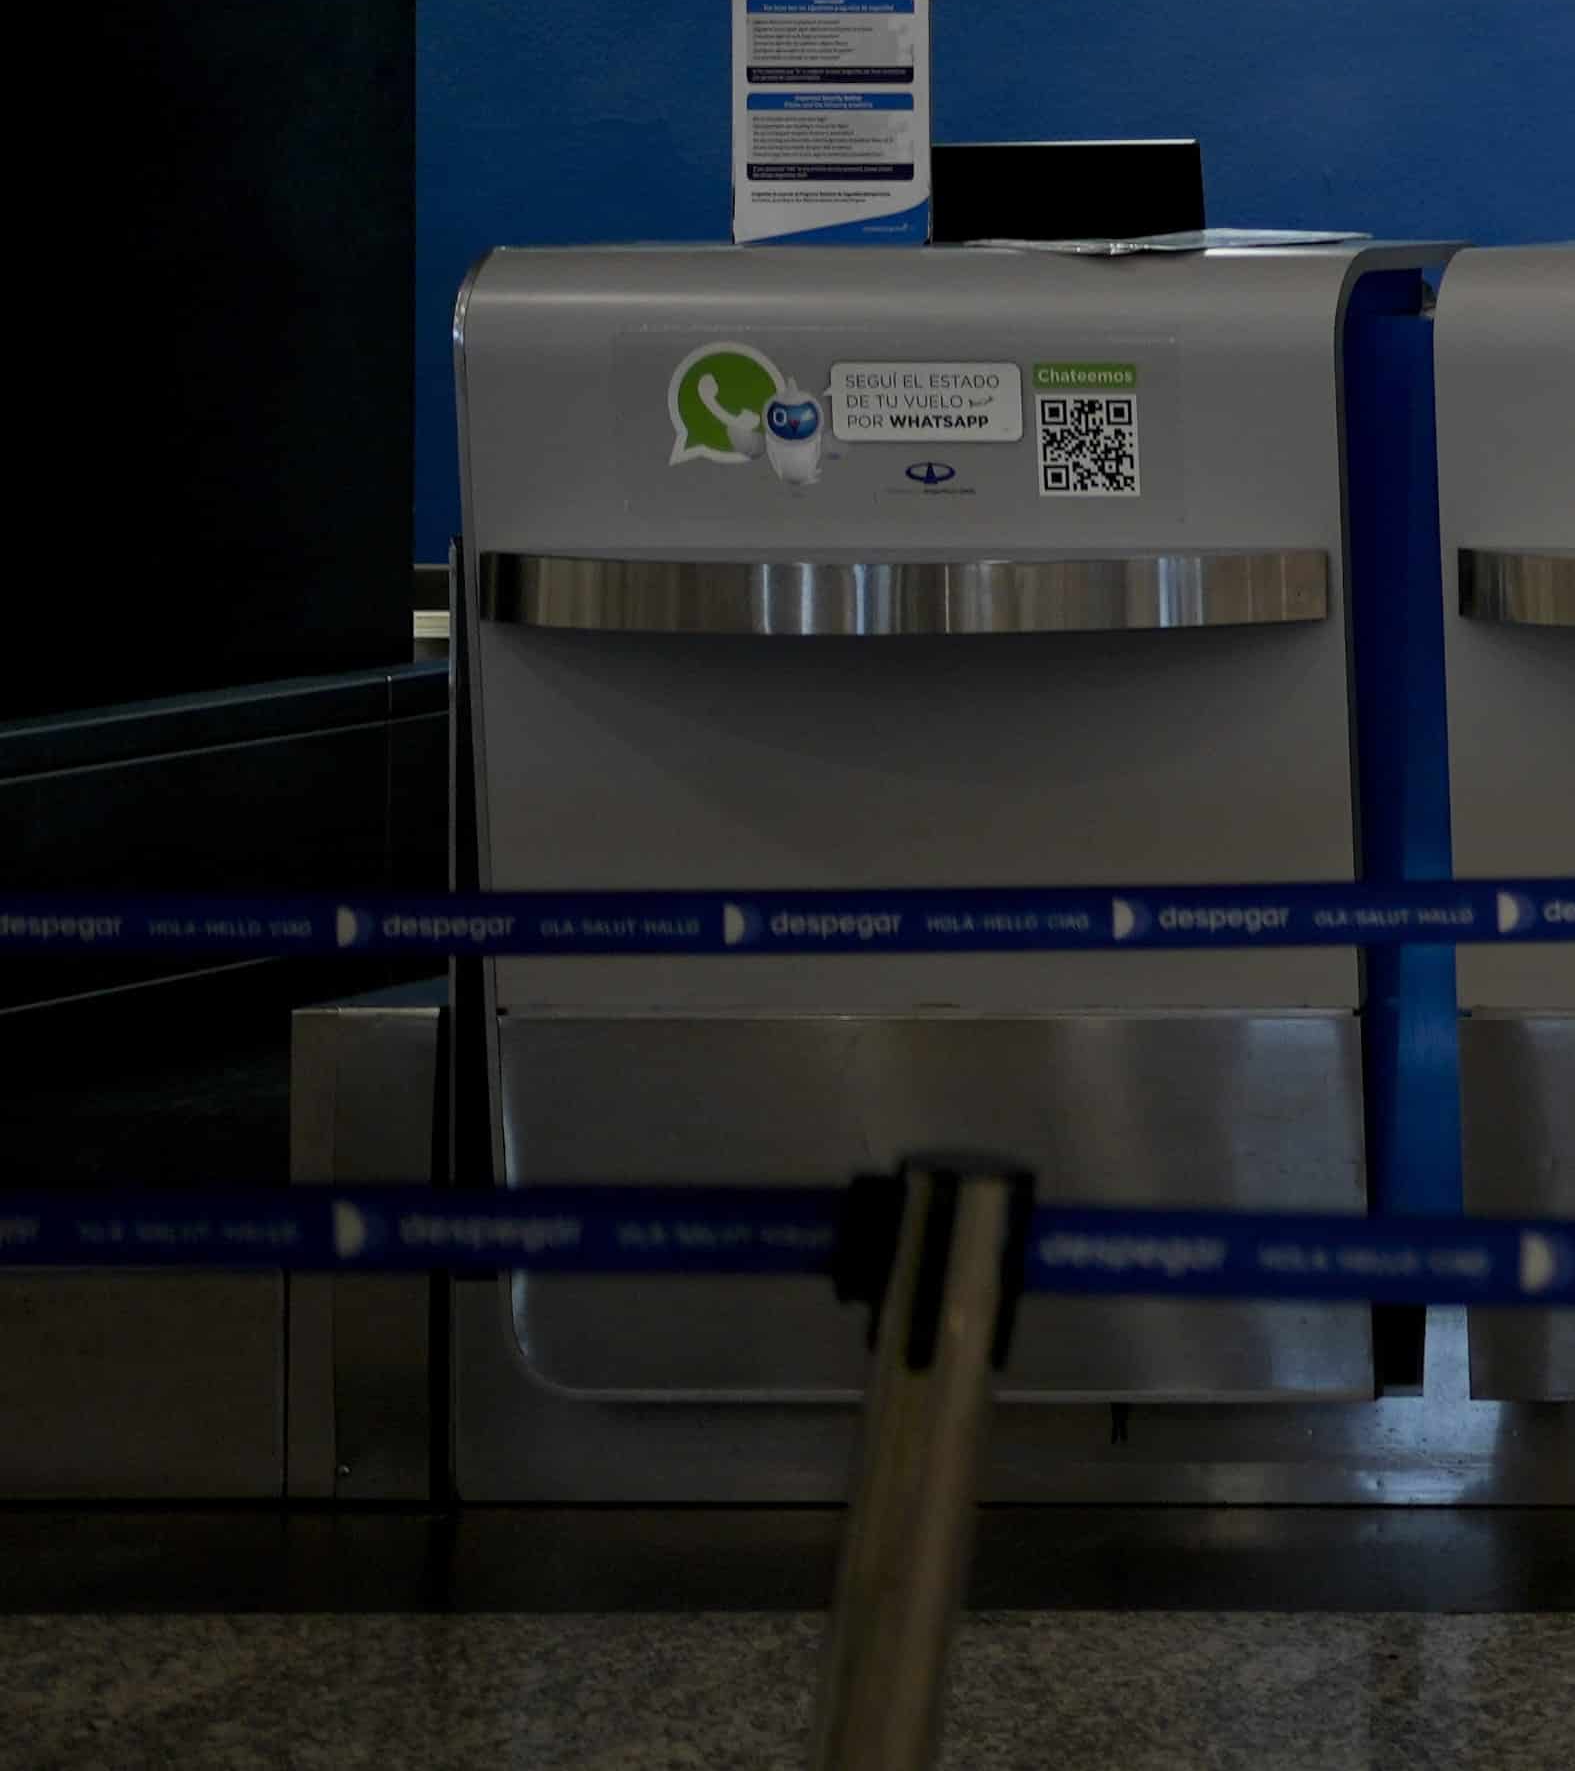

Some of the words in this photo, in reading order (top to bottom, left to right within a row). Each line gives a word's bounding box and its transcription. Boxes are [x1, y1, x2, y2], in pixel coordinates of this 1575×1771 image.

[845, 371, 898, 390] SEGUÍ
[902, 374, 924, 389] EL
[929, 373, 1000, 389] ESTADO
[1037, 366, 1133, 384] Chateemos
[846, 394, 869, 409] DE
[874, 394, 898, 409] TU
[903, 393, 963, 409] VUELO
[847, 414, 884, 429] POR
[889, 414, 990, 429] WHATSAPP
[382, 915, 515, 941] despegar
[770, 912, 901, 940] despegar
[1158, 907, 1289, 933] despegar
